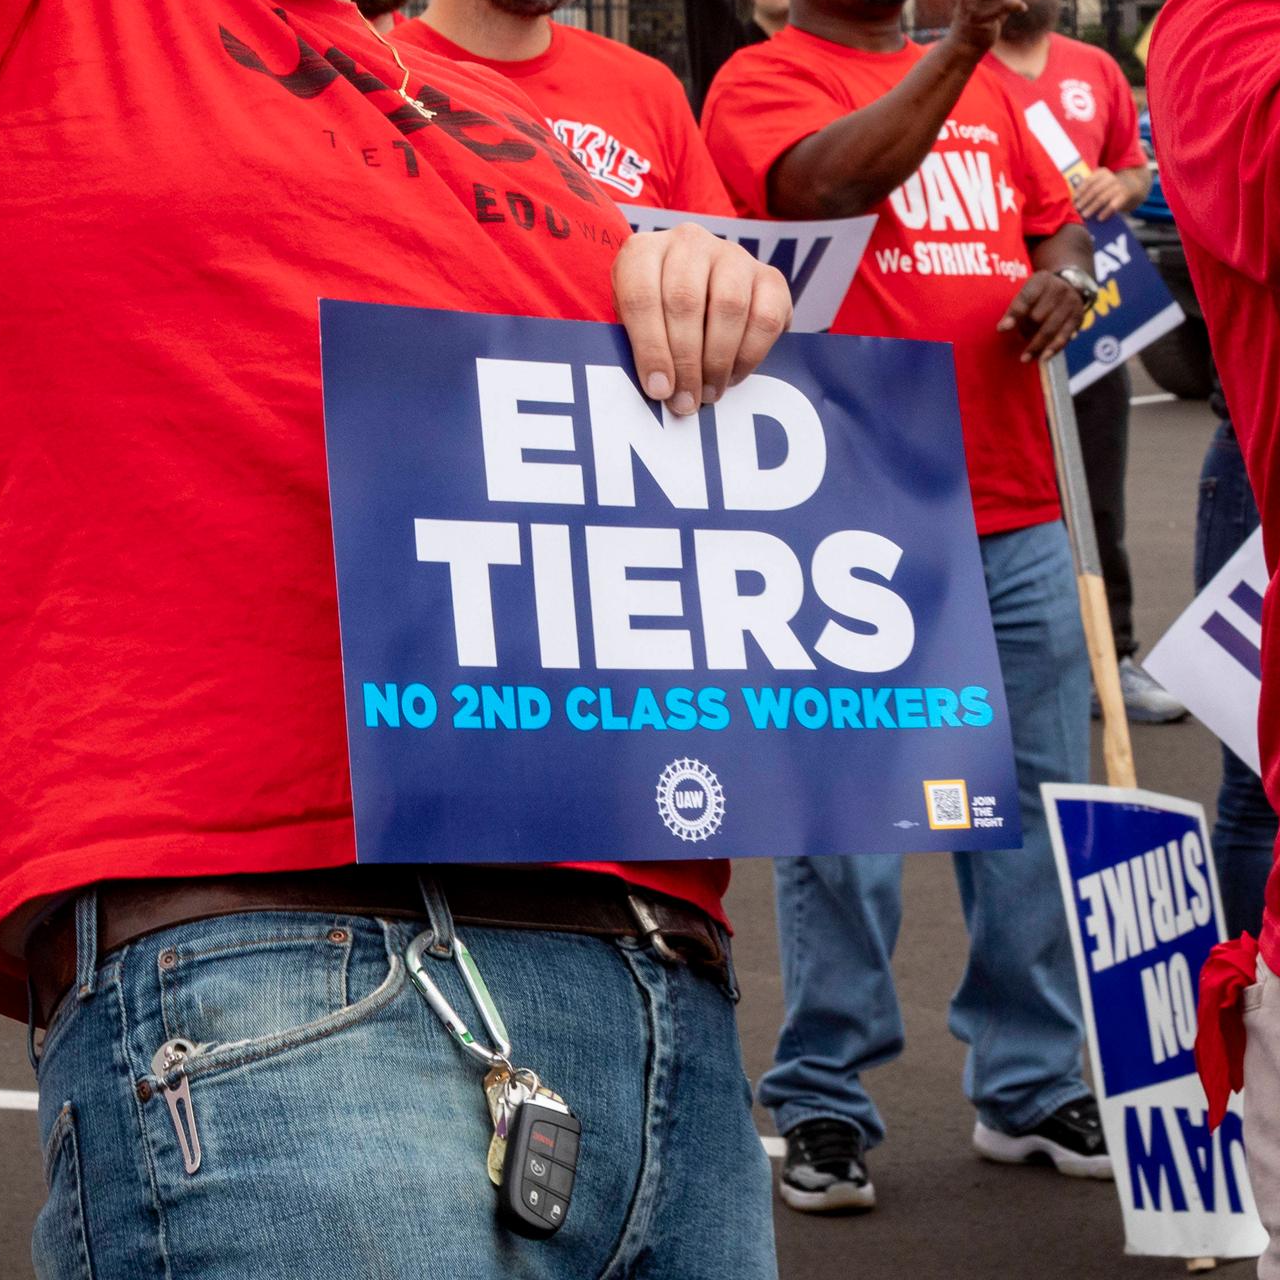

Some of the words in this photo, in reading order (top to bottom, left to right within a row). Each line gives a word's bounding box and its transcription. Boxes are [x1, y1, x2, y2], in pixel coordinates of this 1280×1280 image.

[875, 247, 913, 275] We
[913, 240, 993, 276] STRIKE
[1093, 233, 1131, 283] AY
[475, 356, 828, 512] END
[414, 518, 916, 673] TIERS
[362, 682, 438, 729] NO
[453, 683, 552, 730] 2ND
[565, 686, 730, 732] CLASS
[741, 685, 994, 730] WORKERS
[675, 790, 704, 809] UAW
[971, 796, 996, 807] JOIN
[972, 807, 994, 817] THE
[973, 817, 1004, 828] FIGHT
[1078, 830, 1213, 973] STRIKE
[1140, 951, 1198, 1066] ON
